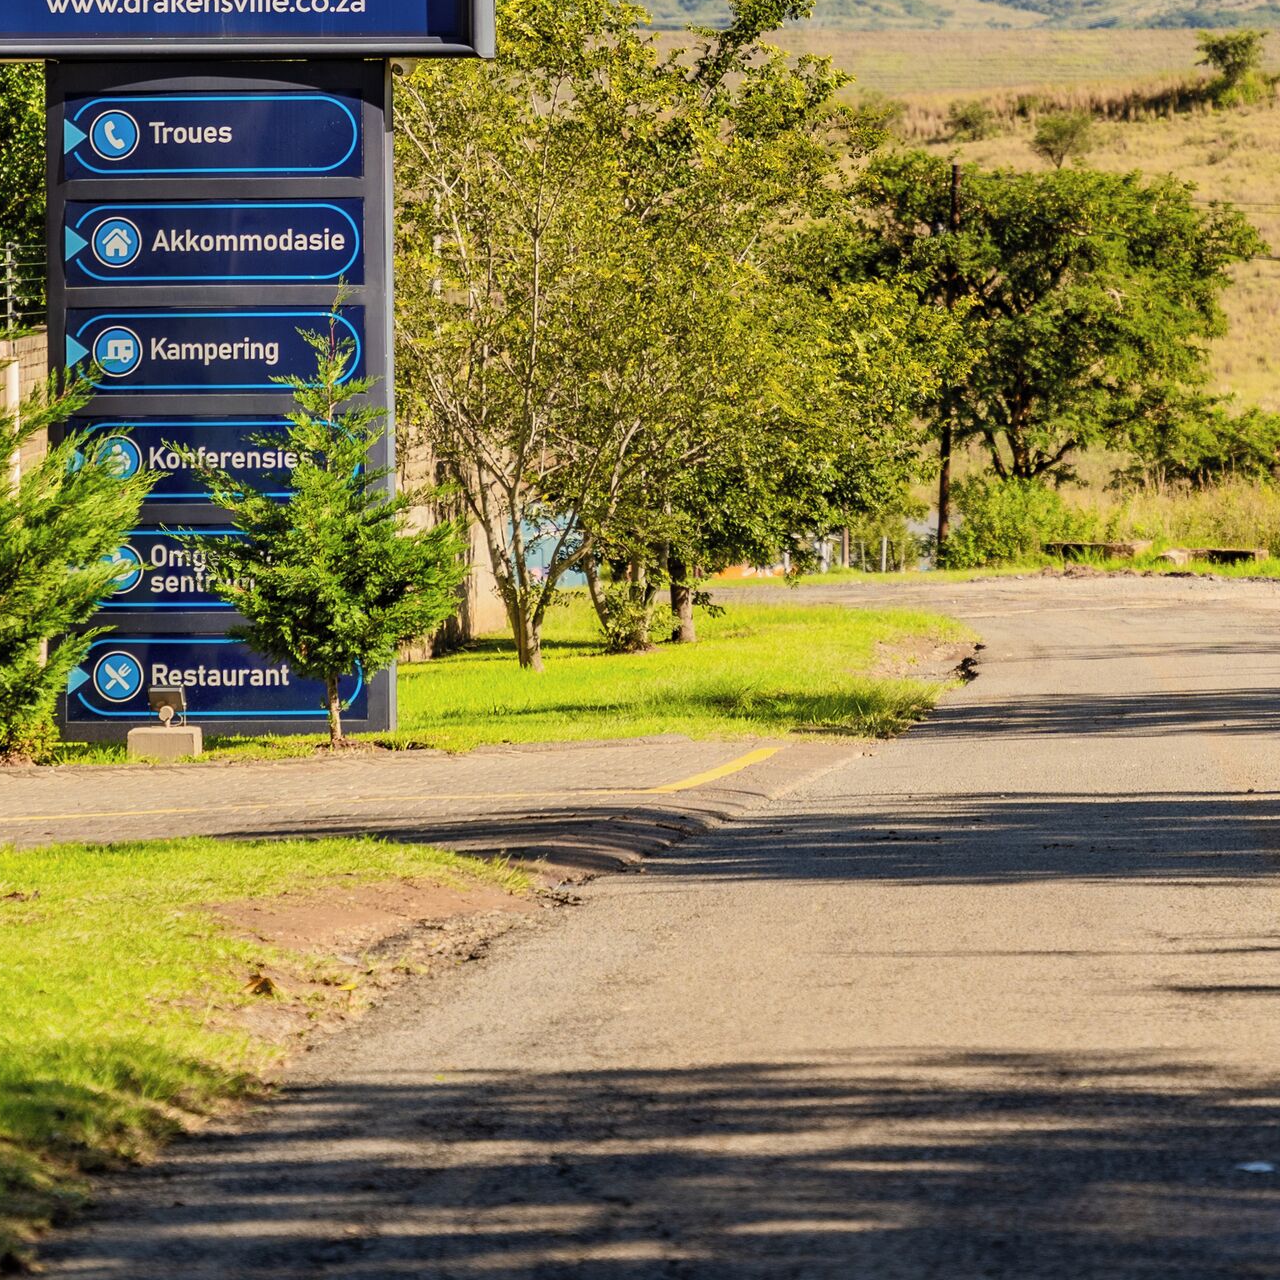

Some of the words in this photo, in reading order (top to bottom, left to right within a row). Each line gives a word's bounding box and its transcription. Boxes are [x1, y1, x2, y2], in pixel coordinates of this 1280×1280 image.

[149, 121, 233, 145] Troues
[151, 228, 346, 252] Akkommodasie
[150, 337, 280, 366] Kampering
[151, 663, 290, 687] Restaurant
